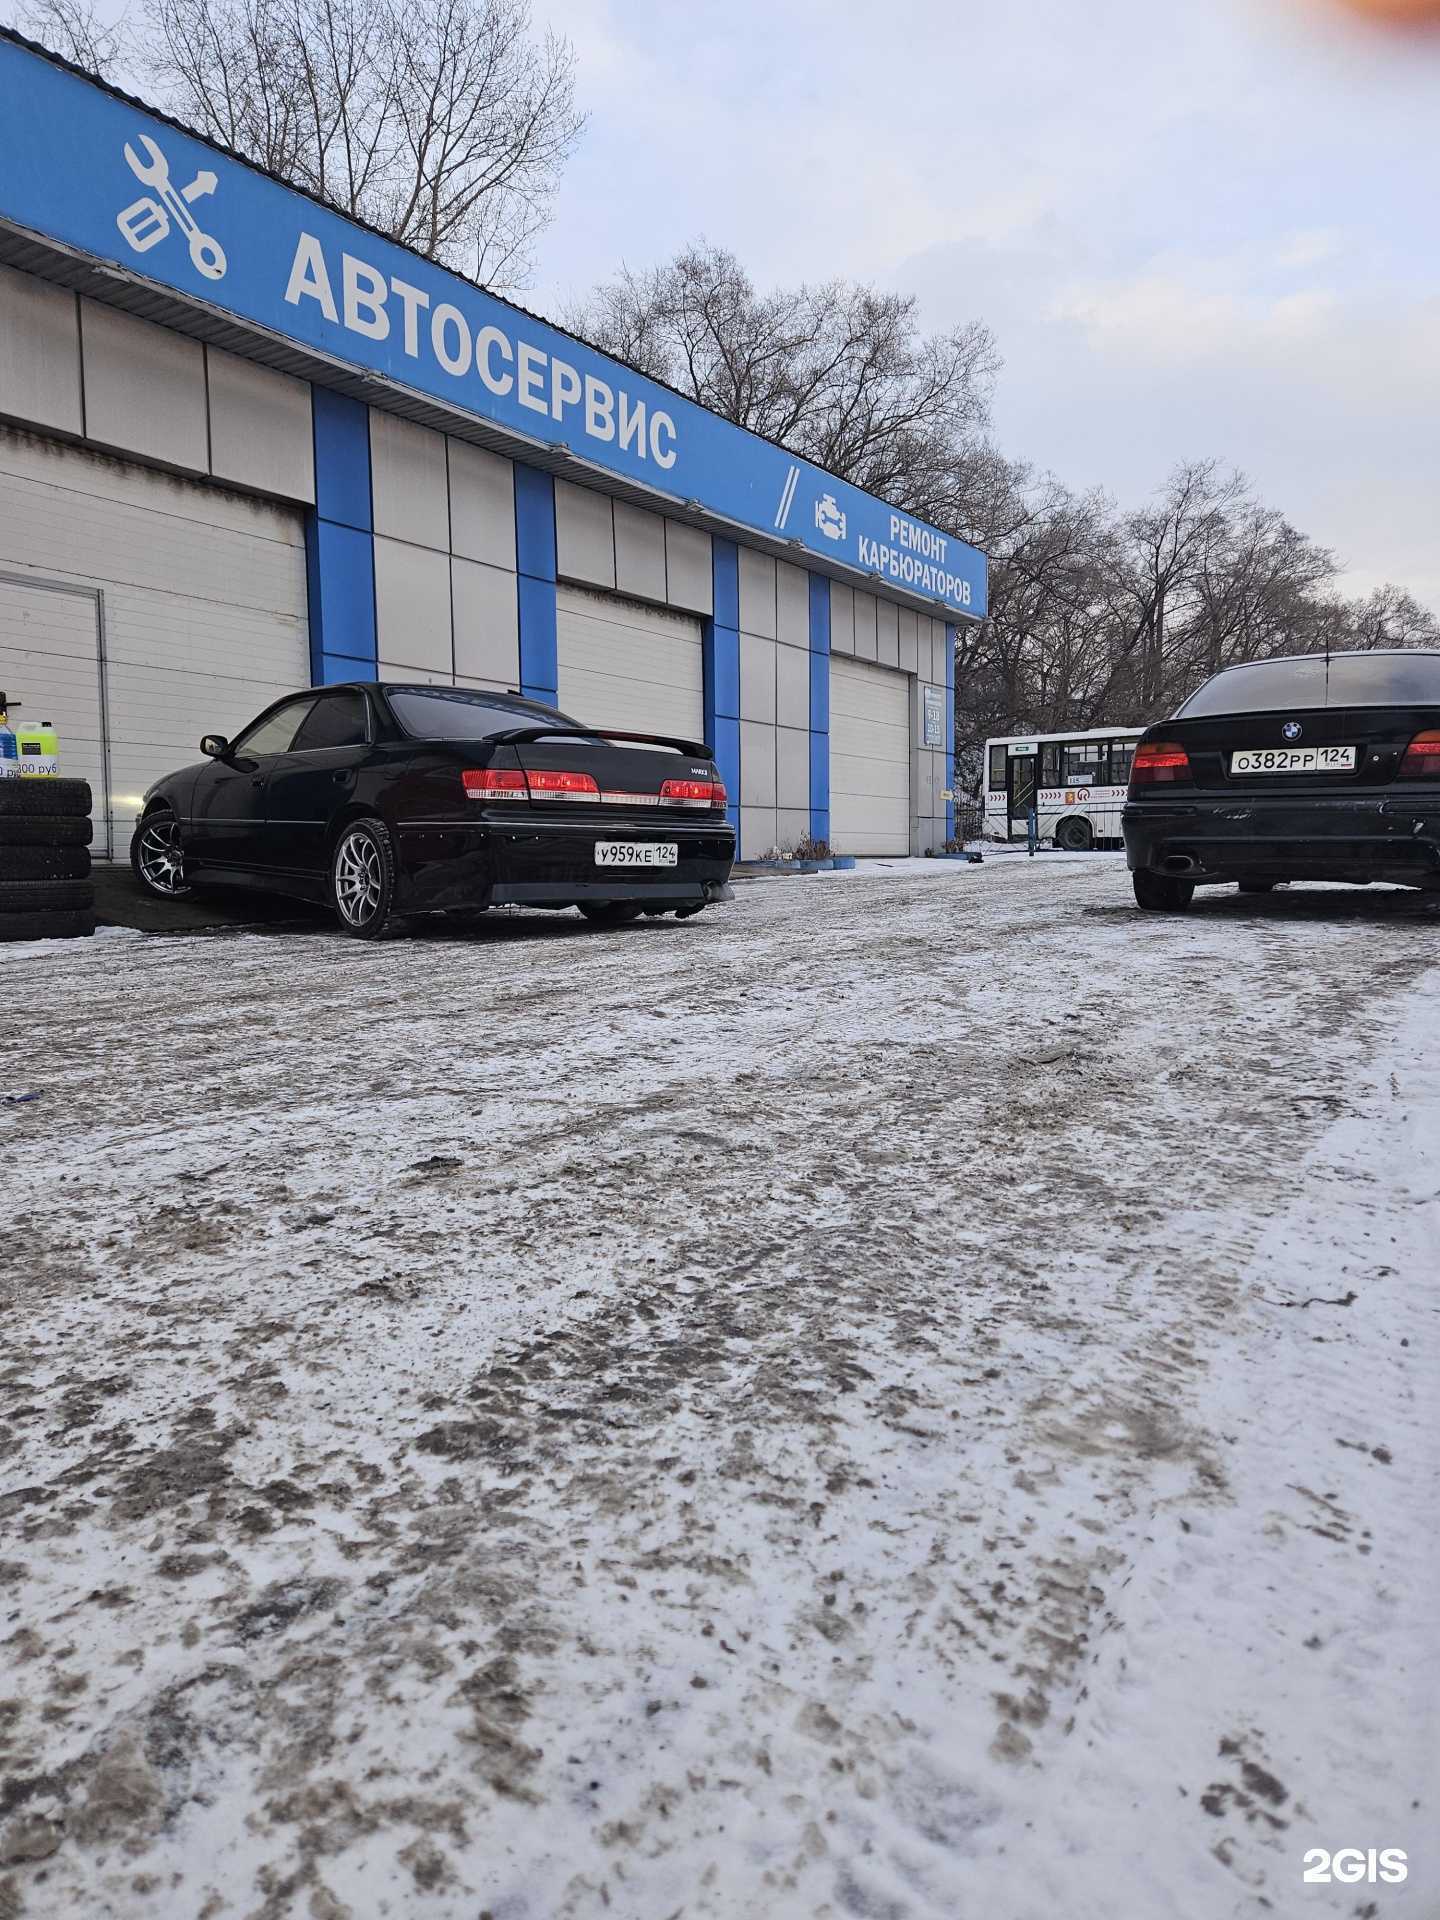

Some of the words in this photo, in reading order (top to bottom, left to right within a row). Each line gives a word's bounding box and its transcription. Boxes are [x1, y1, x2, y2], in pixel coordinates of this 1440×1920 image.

[284, 231, 677, 470] АВТОСЕРВИС
[890, 515, 948, 564] РЕМОНТ
[858, 535, 971, 606] КАРБЮРАТОРОВ
[39, 764, 57, 775] руб
[1320, 748, 1350, 763] 124
[655, 846, 676, 859] 124
